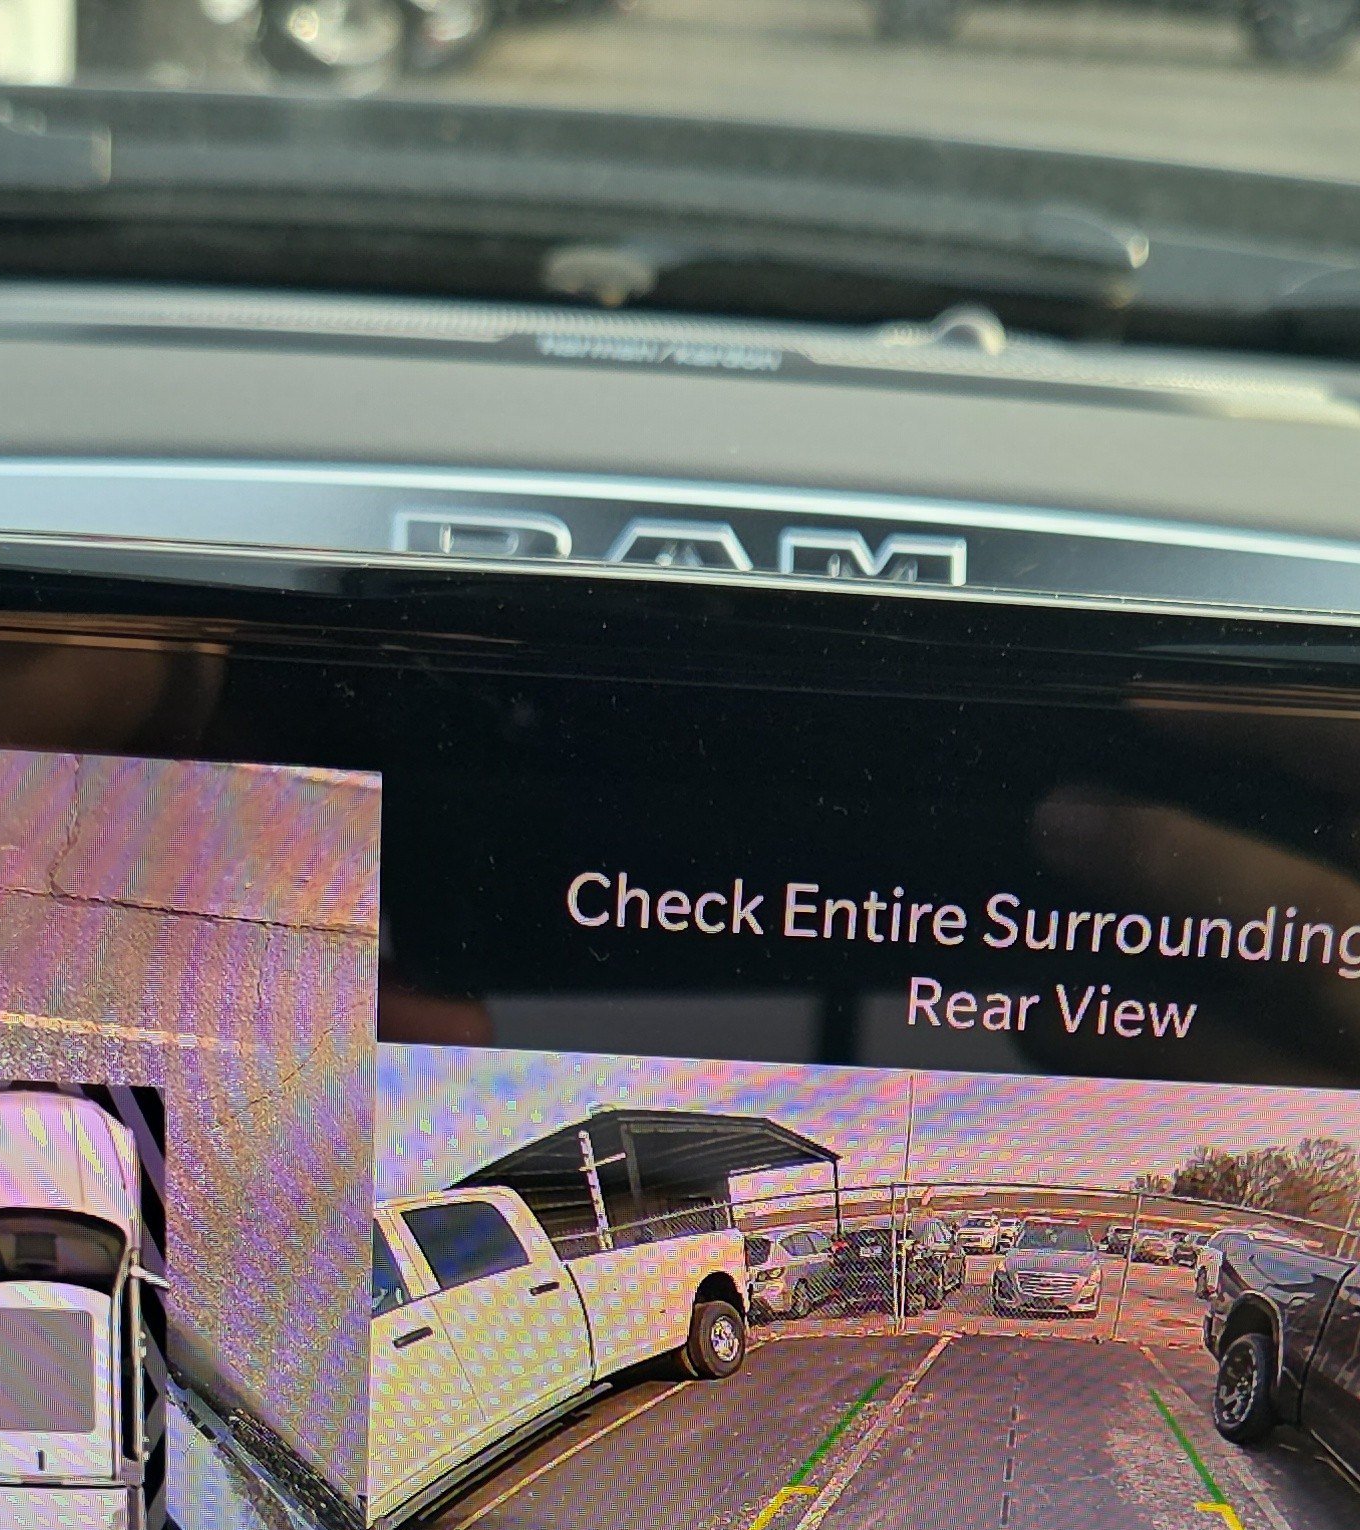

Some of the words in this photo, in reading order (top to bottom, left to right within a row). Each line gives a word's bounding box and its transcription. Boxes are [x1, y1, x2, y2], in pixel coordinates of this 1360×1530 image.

[566, 871, 766, 936] Check
[784, 882, 968, 948] Entire
[906, 976, 1040, 1032] Rear
[1054, 983, 1198, 1041] View
